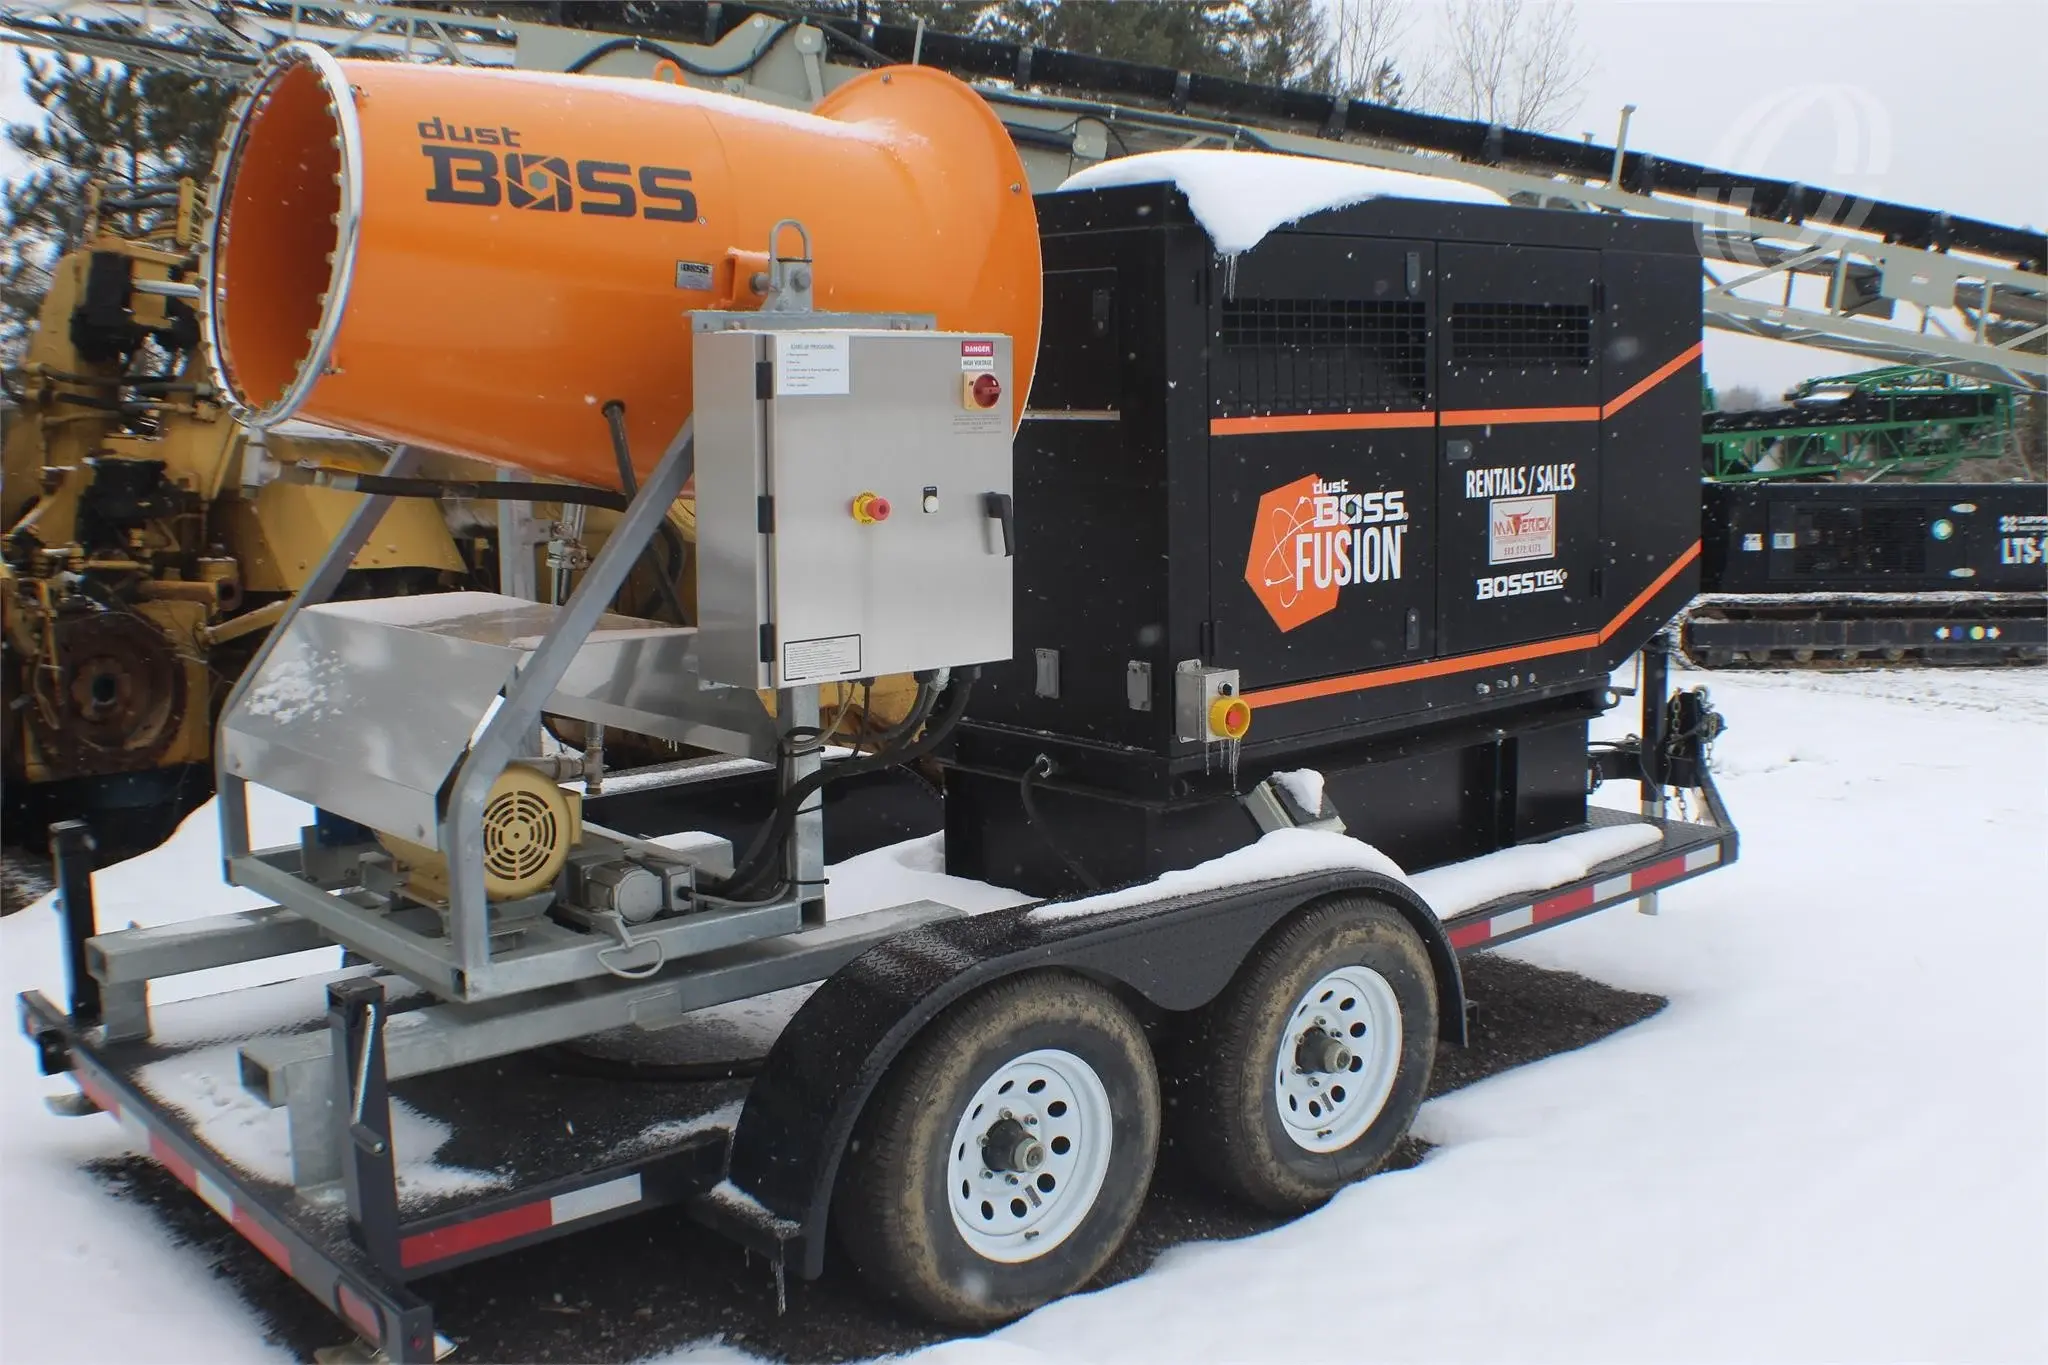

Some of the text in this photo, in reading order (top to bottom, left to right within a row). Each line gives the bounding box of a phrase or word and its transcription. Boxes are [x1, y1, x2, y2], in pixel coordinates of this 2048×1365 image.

[417, 116, 521, 147] dust
[421, 144, 699, 223] BOSS
[964, 345, 991, 353] DANGER
[1312, 478, 1350, 494] dust
[1313, 491, 1405, 528] BOSS
[1296, 525, 1402, 591] FUSION
